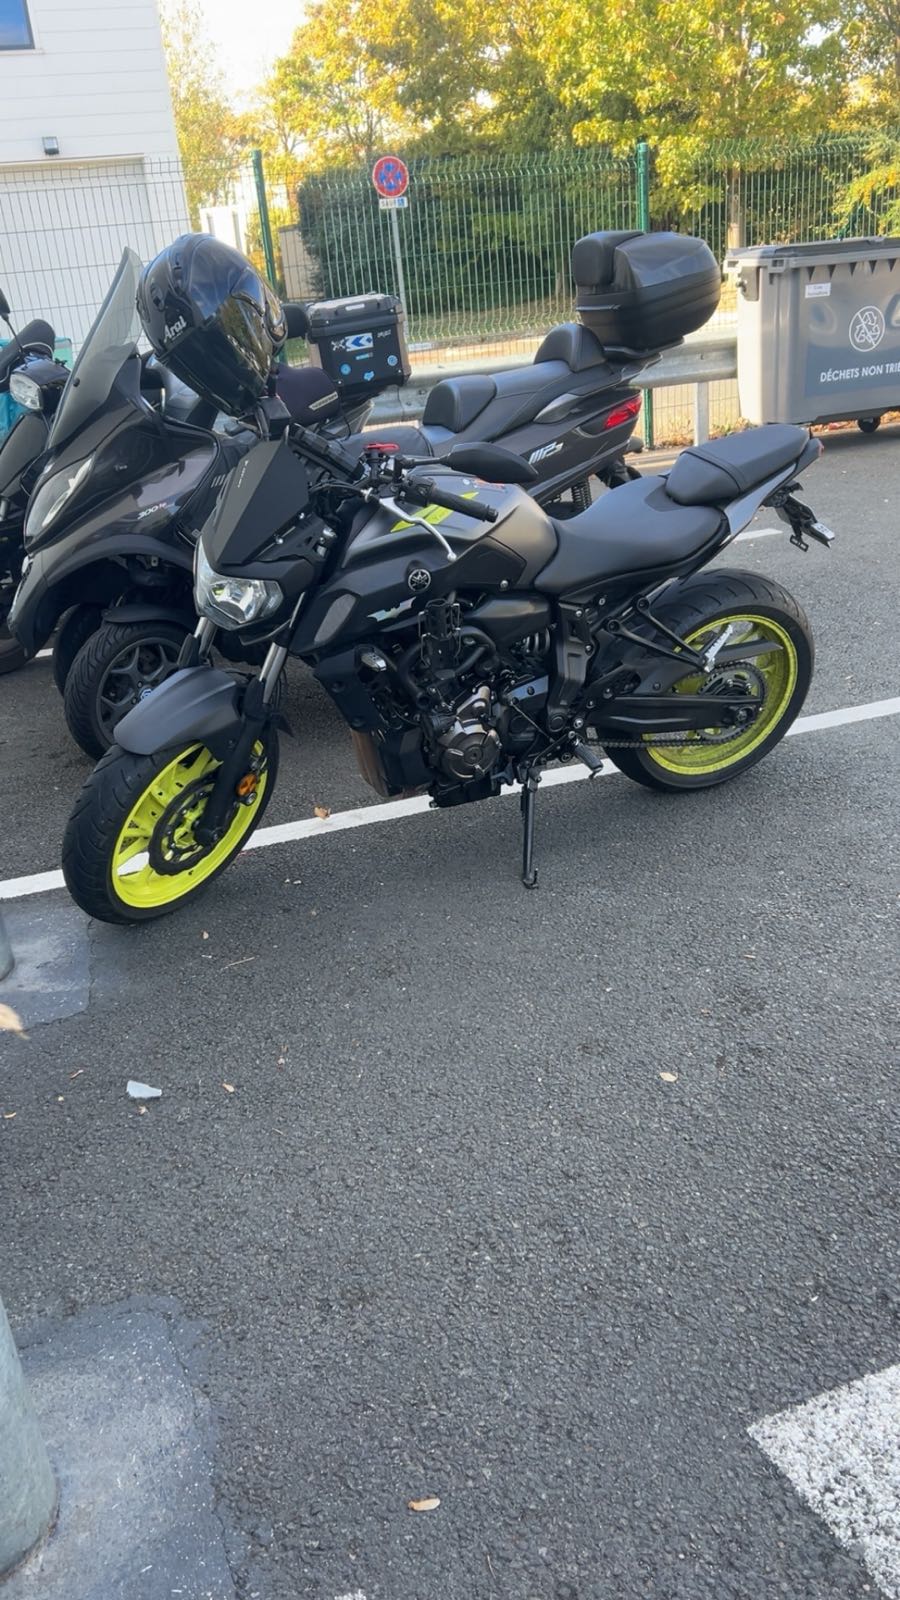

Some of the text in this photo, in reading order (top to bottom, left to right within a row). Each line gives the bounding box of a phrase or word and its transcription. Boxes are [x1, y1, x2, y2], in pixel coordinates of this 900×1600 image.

[163, 315, 187, 343] Arai
[820, 368, 860, 382] DÉCHETS
[861, 365, 884, 377] NON
[137, 505, 159, 520] 300
